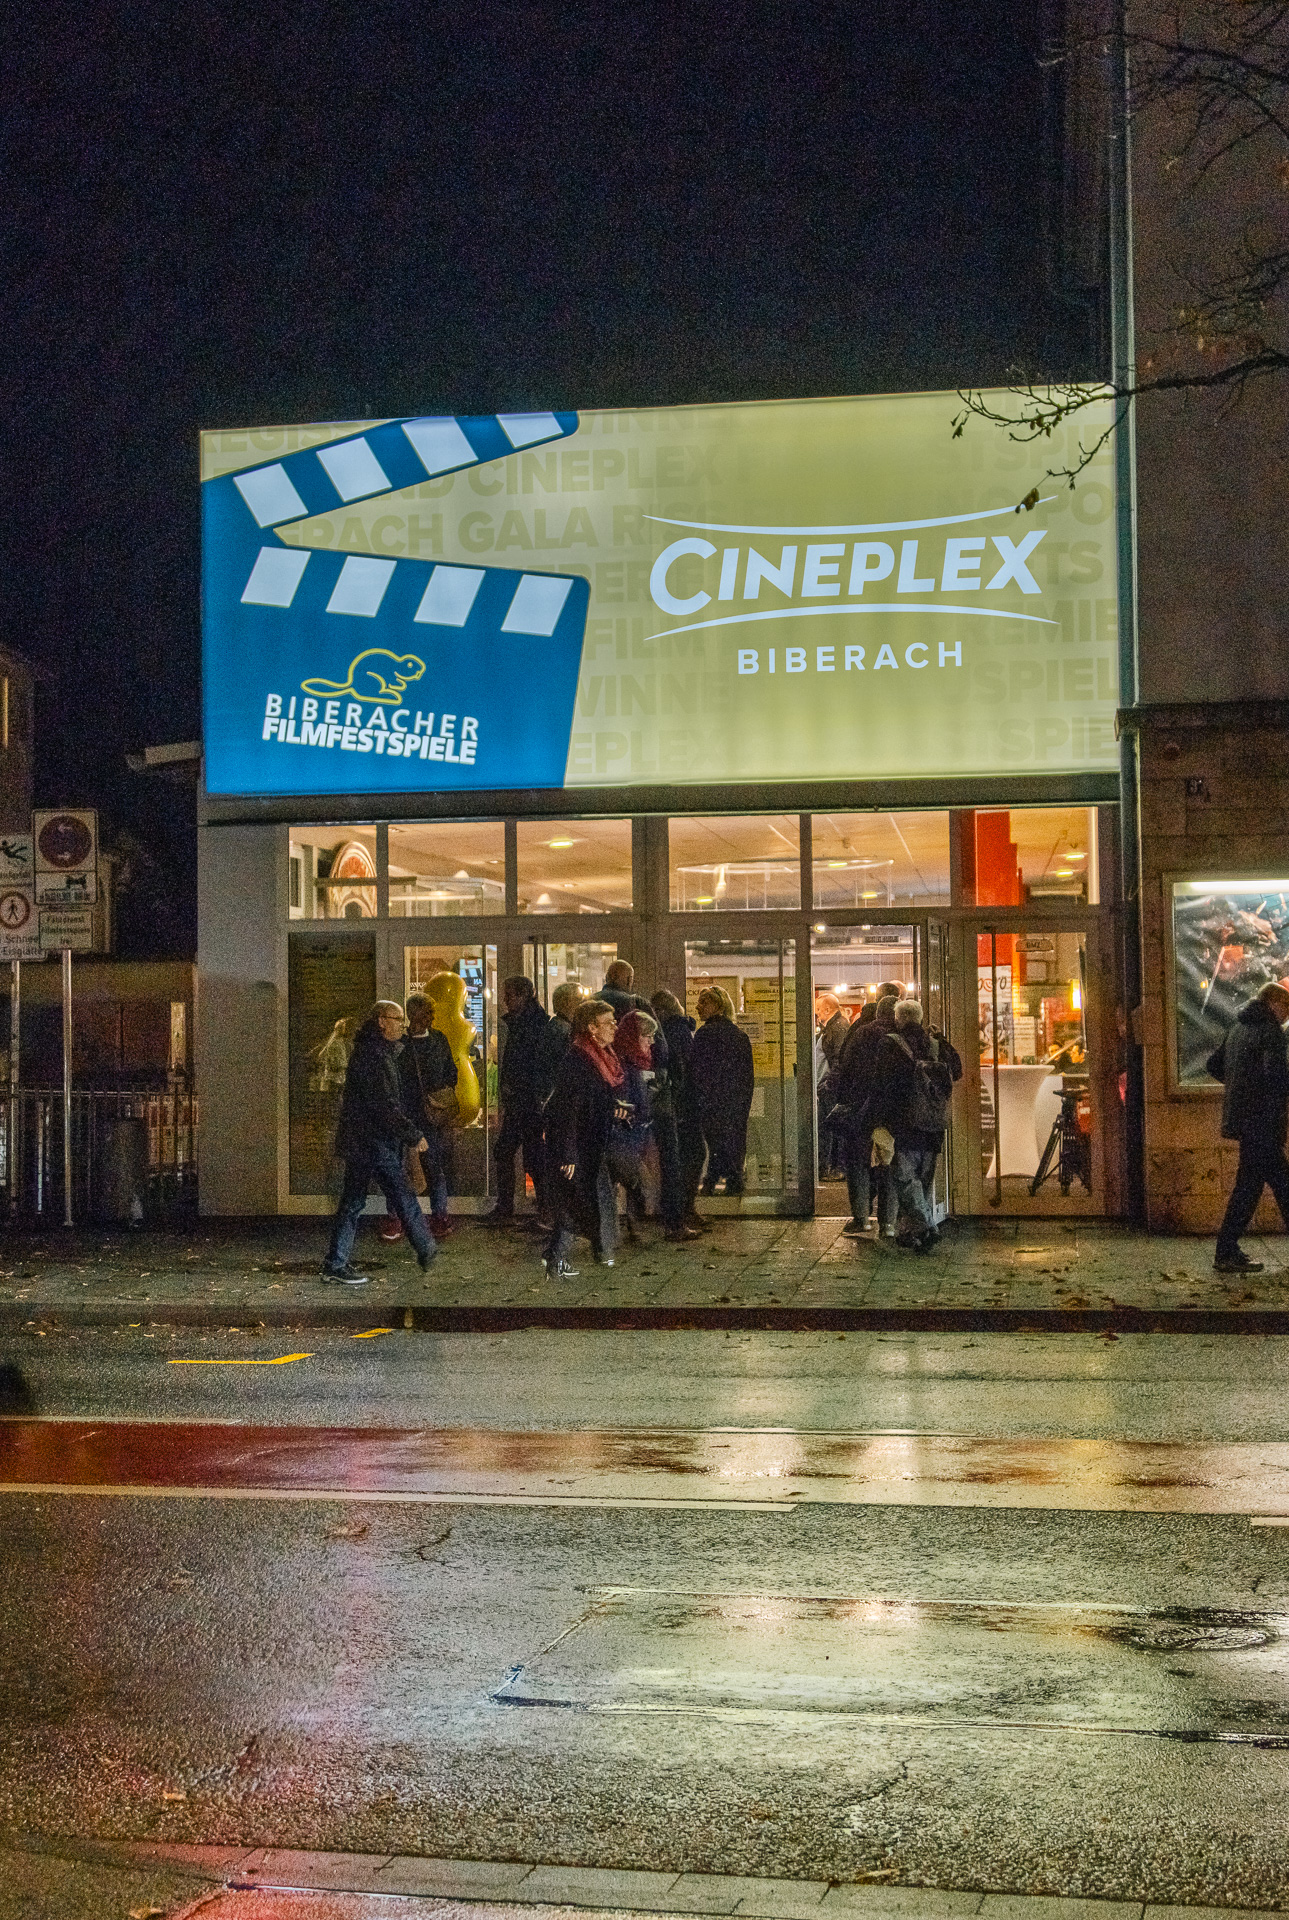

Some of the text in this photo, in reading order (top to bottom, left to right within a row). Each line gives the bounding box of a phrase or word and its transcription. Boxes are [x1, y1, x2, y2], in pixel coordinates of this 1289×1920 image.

[649, 530, 1048, 616] CINEPLEX
[738, 641, 964, 675] BIBERACH
[265, 693, 479, 740] BIBERACHER
[262, 717, 478, 765] FILMFESTSPIELE
